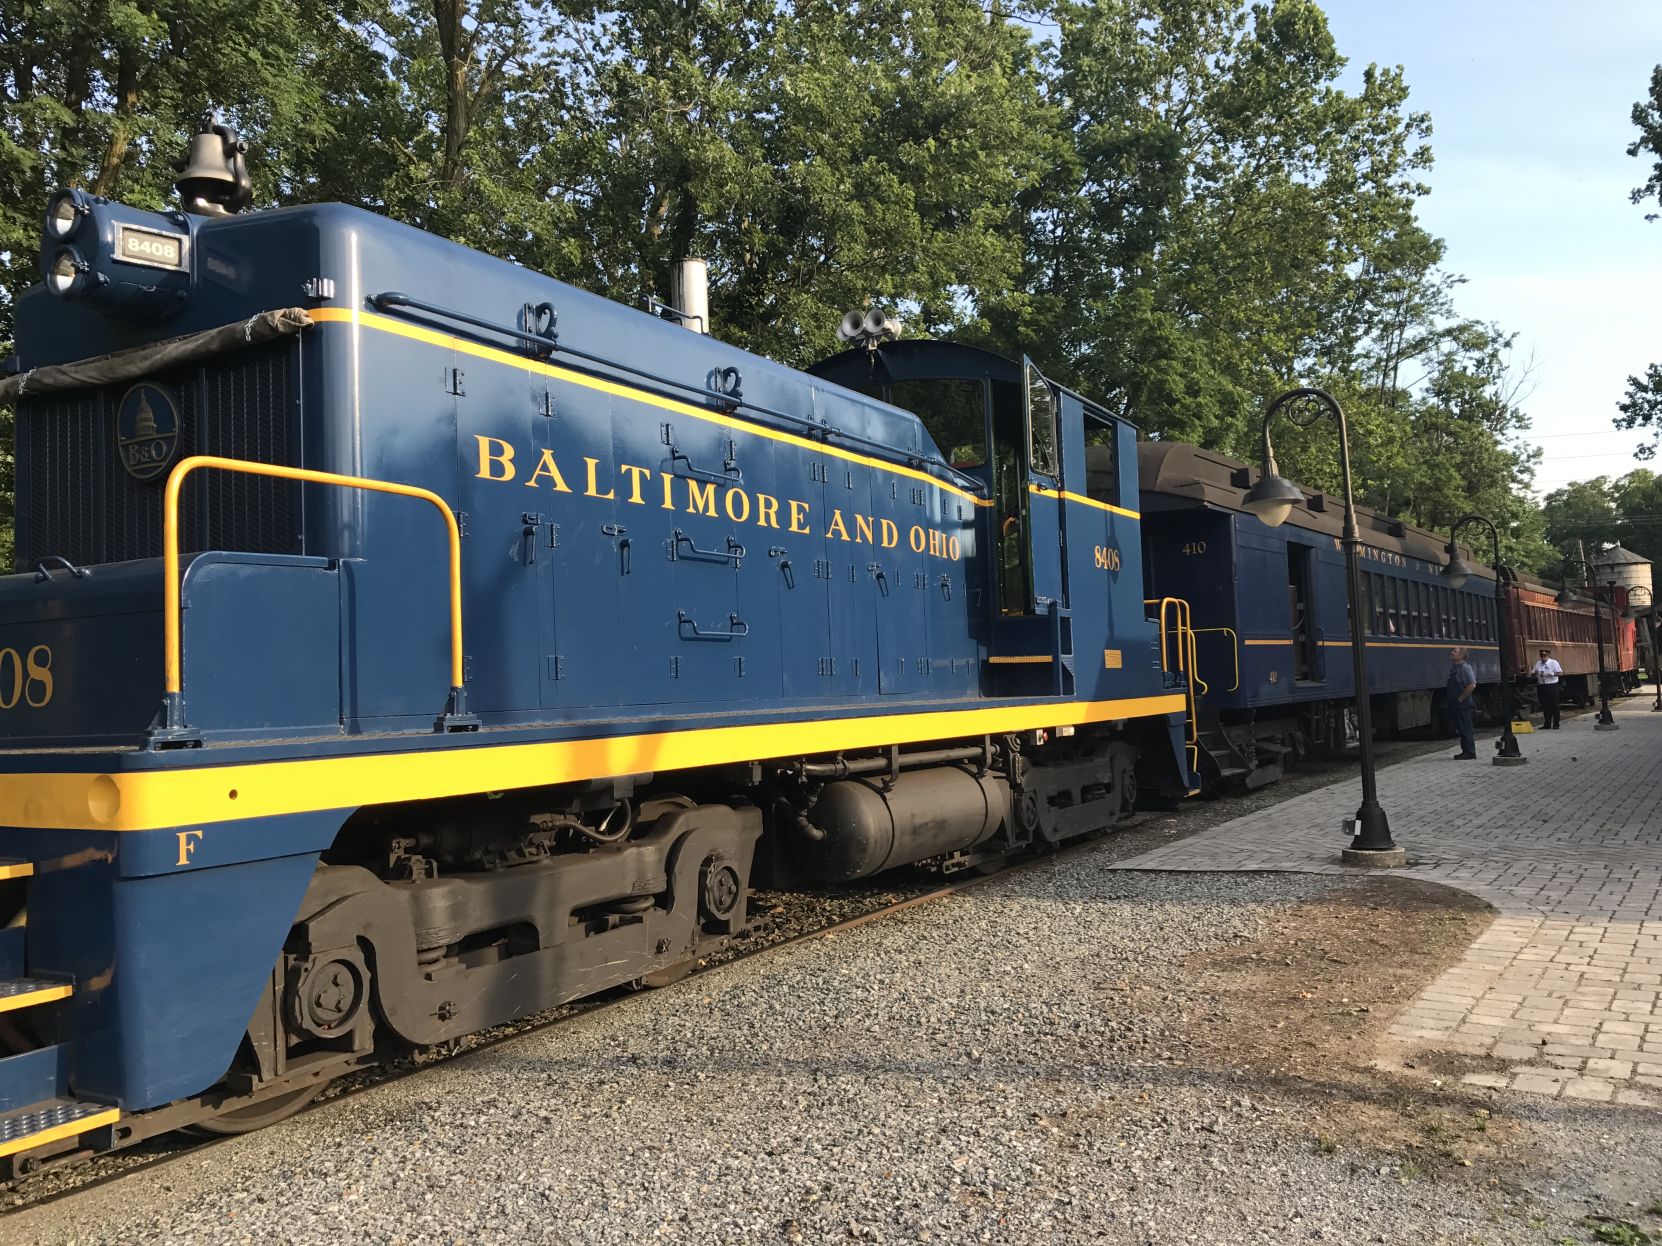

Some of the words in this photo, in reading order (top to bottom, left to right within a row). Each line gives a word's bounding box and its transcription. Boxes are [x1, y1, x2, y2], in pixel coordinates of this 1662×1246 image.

[127, 237, 176, 259] 8408
[129, 440, 166, 465] B&O
[473, 434, 811, 535] BALTIMORE
[825, 508, 900, 549] AND
[909, 524, 962, 562] OHIO
[1094, 545, 1120, 571] 8408
[1182, 541, 1207, 556] 410
[1334, 538, 1407, 569] WMINGTON
[175, 830, 203, 866] F
